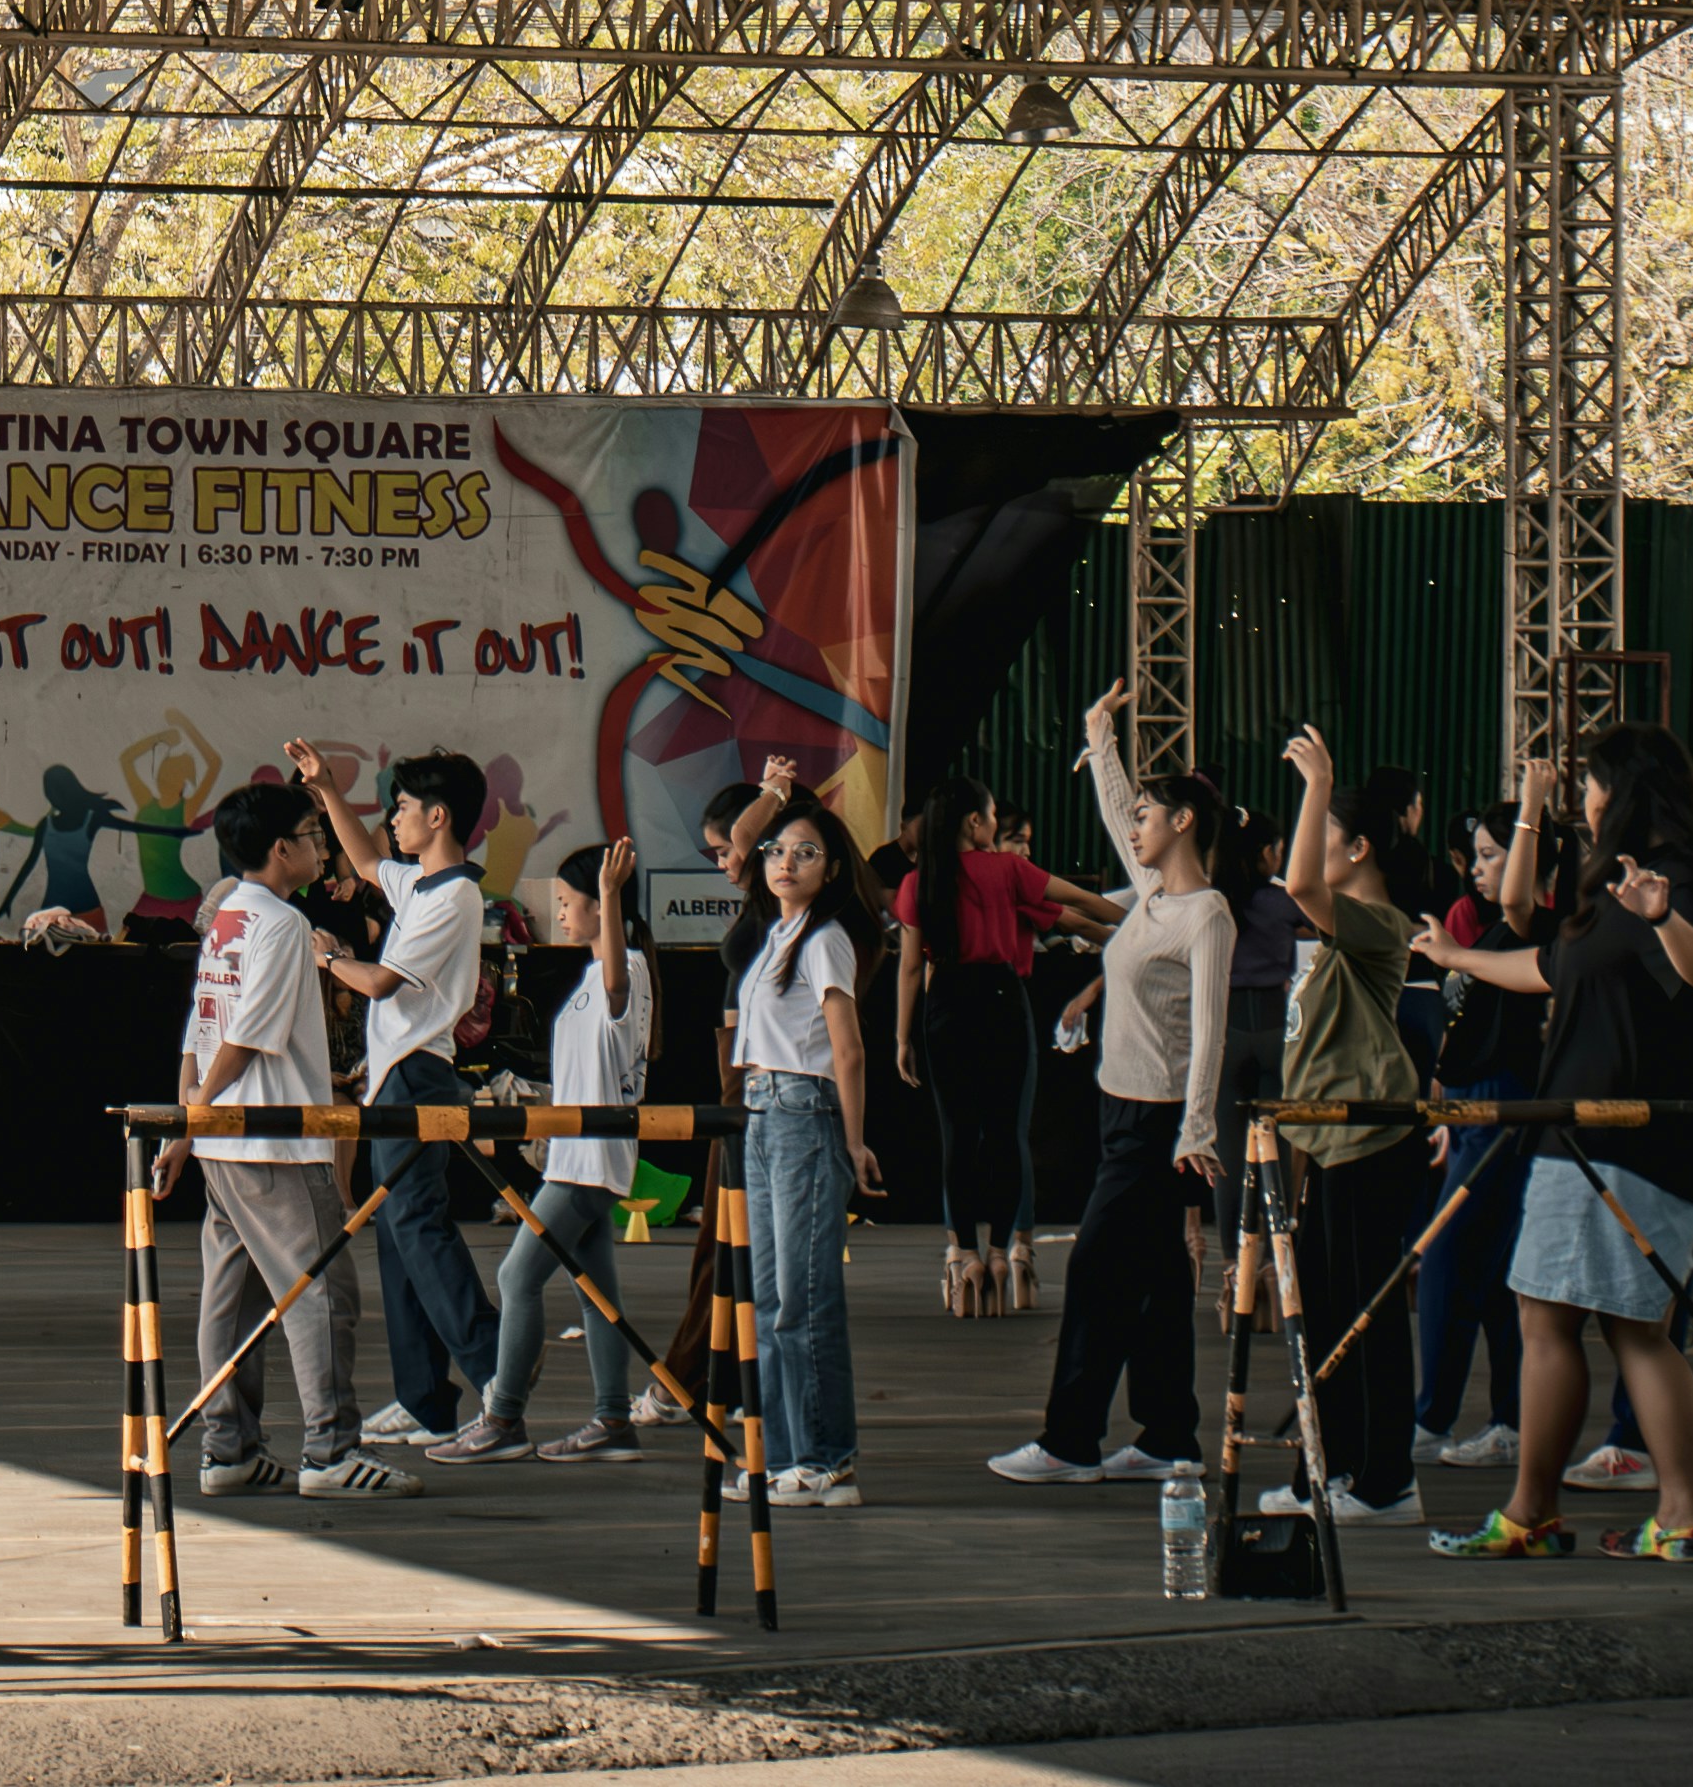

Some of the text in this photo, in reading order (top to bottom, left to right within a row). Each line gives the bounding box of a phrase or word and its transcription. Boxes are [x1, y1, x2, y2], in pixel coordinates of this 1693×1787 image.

[119, 416, 268, 457] TOWN
[283, 420, 472, 464] SQUARE
[193, 465, 491, 540] FITNESS
[82, 541, 170, 564] FRIDAY
[197, 544, 252, 565] 6:30
[260, 546, 299, 566] PM
[320, 547, 374, 567] 7:30
[381, 547, 420, 568] PM
[60, 606, 174, 675] OUT!
[199, 603, 386, 676] DANCE
[475, 611, 586, 679] OUT!
